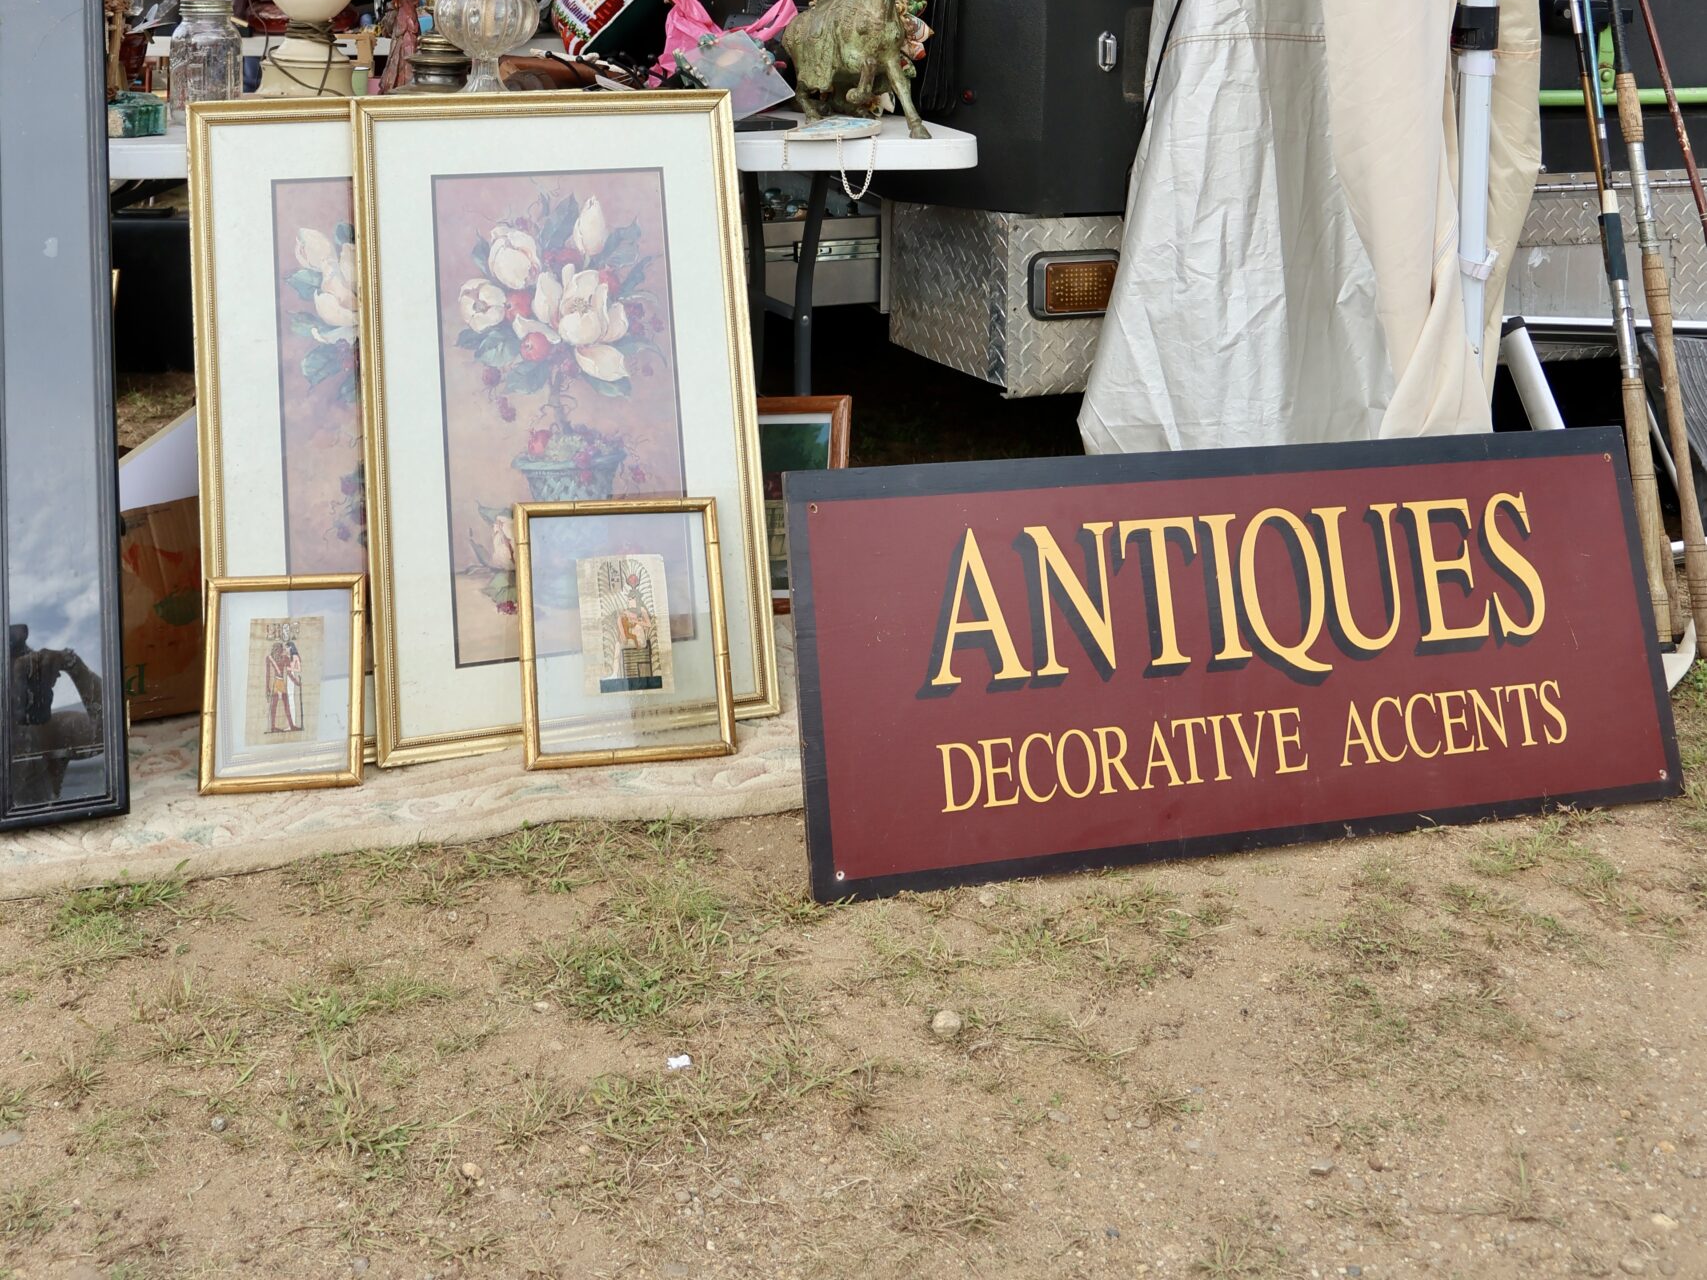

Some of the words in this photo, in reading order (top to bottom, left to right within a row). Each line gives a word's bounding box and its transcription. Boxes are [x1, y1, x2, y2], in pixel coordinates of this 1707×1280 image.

[931, 491, 1546, 685] ANTIQUES
[935, 707, 1308, 813] DECORATIVE
[1340, 679, 1568, 767] ACCENTS
